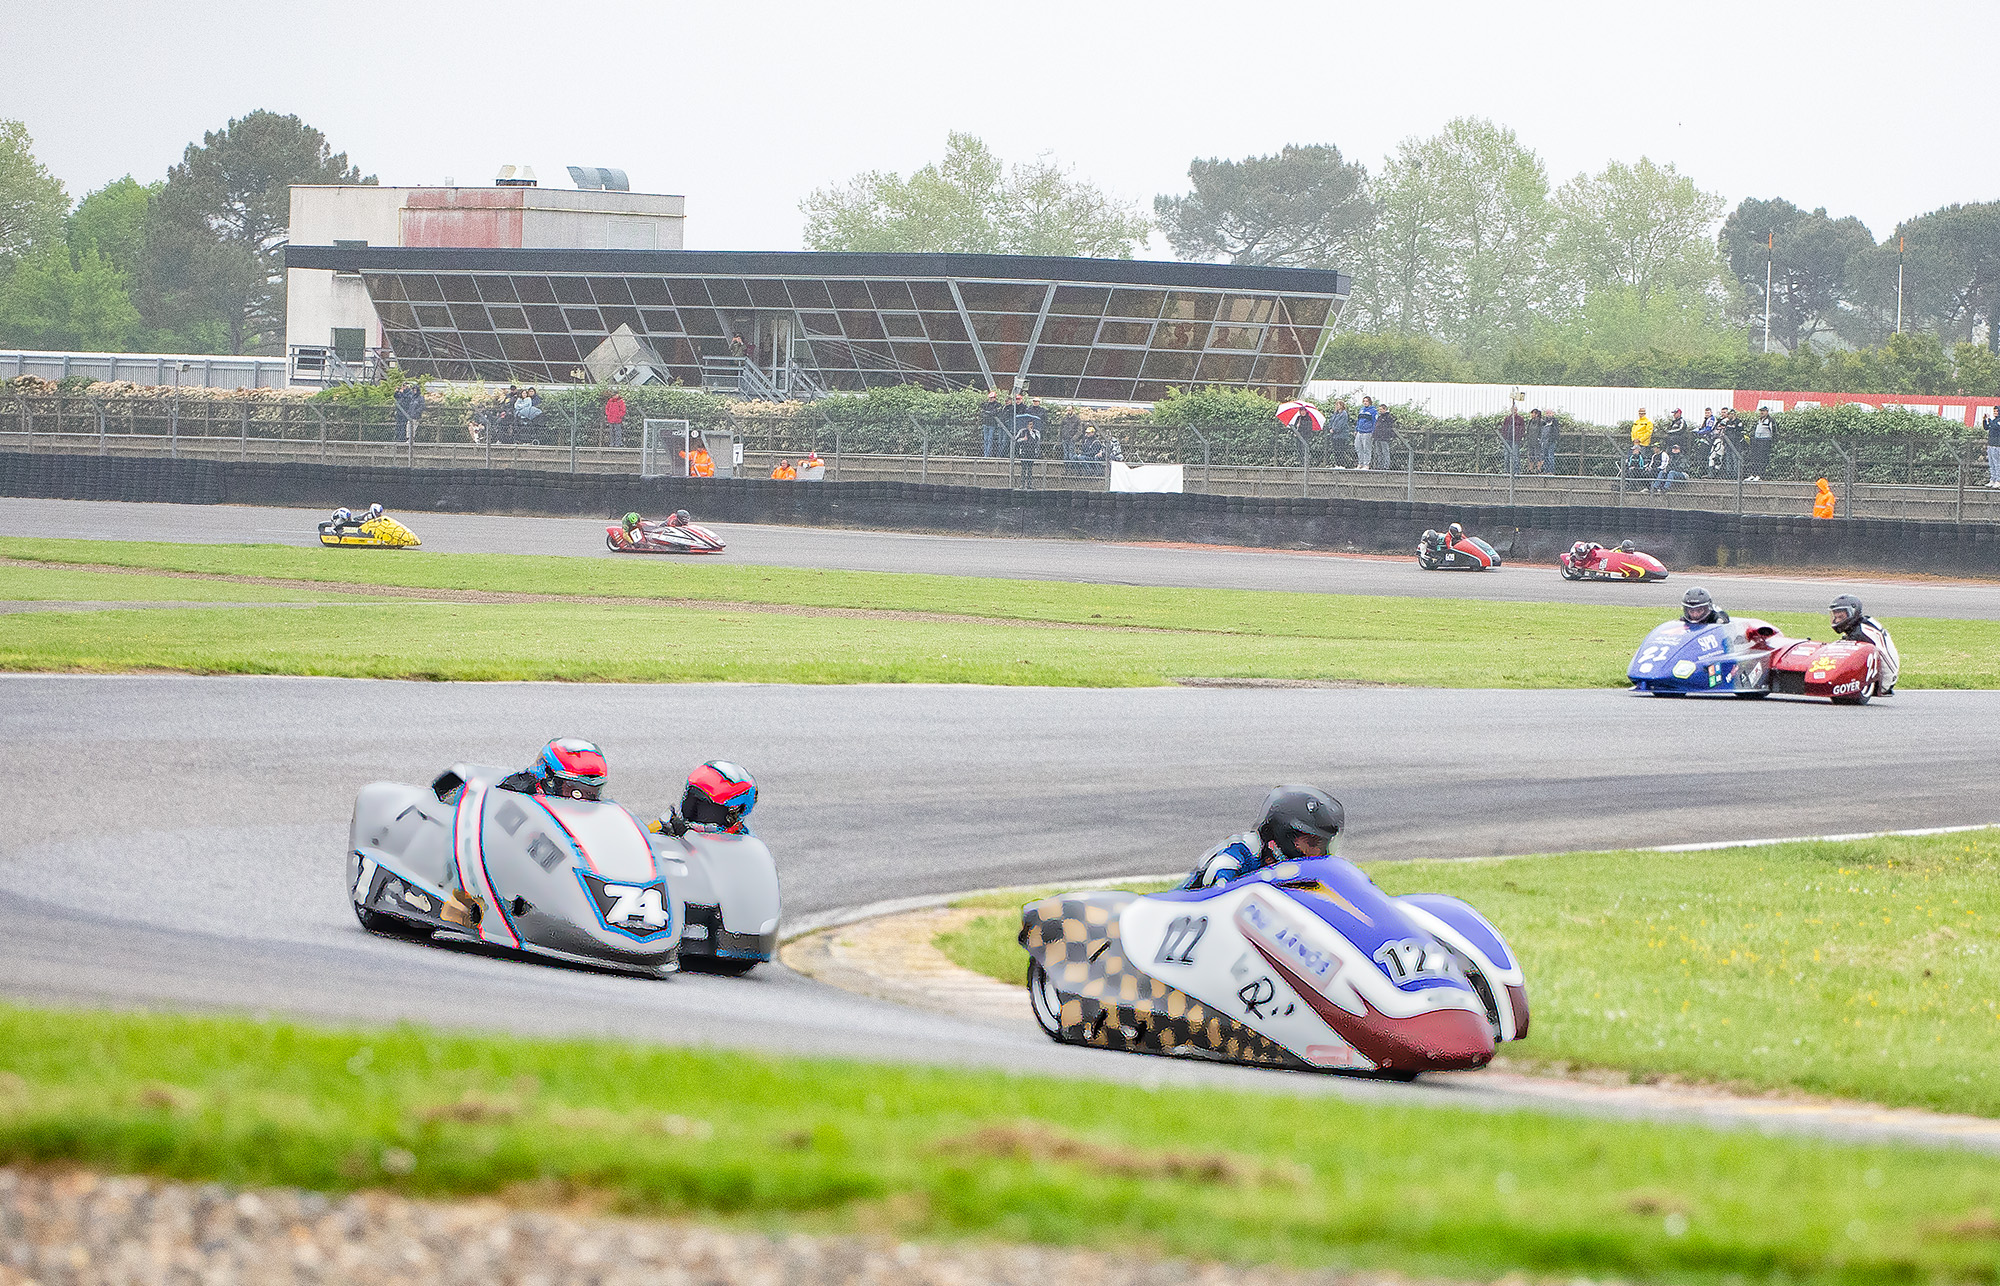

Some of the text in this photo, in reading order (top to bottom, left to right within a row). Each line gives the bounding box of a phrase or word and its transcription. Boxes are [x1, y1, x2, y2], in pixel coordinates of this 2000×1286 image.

[1697, 634, 1719, 652] SPB
[1637, 645, 1670, 664] 21
[1865, 651, 1878, 682] 21
